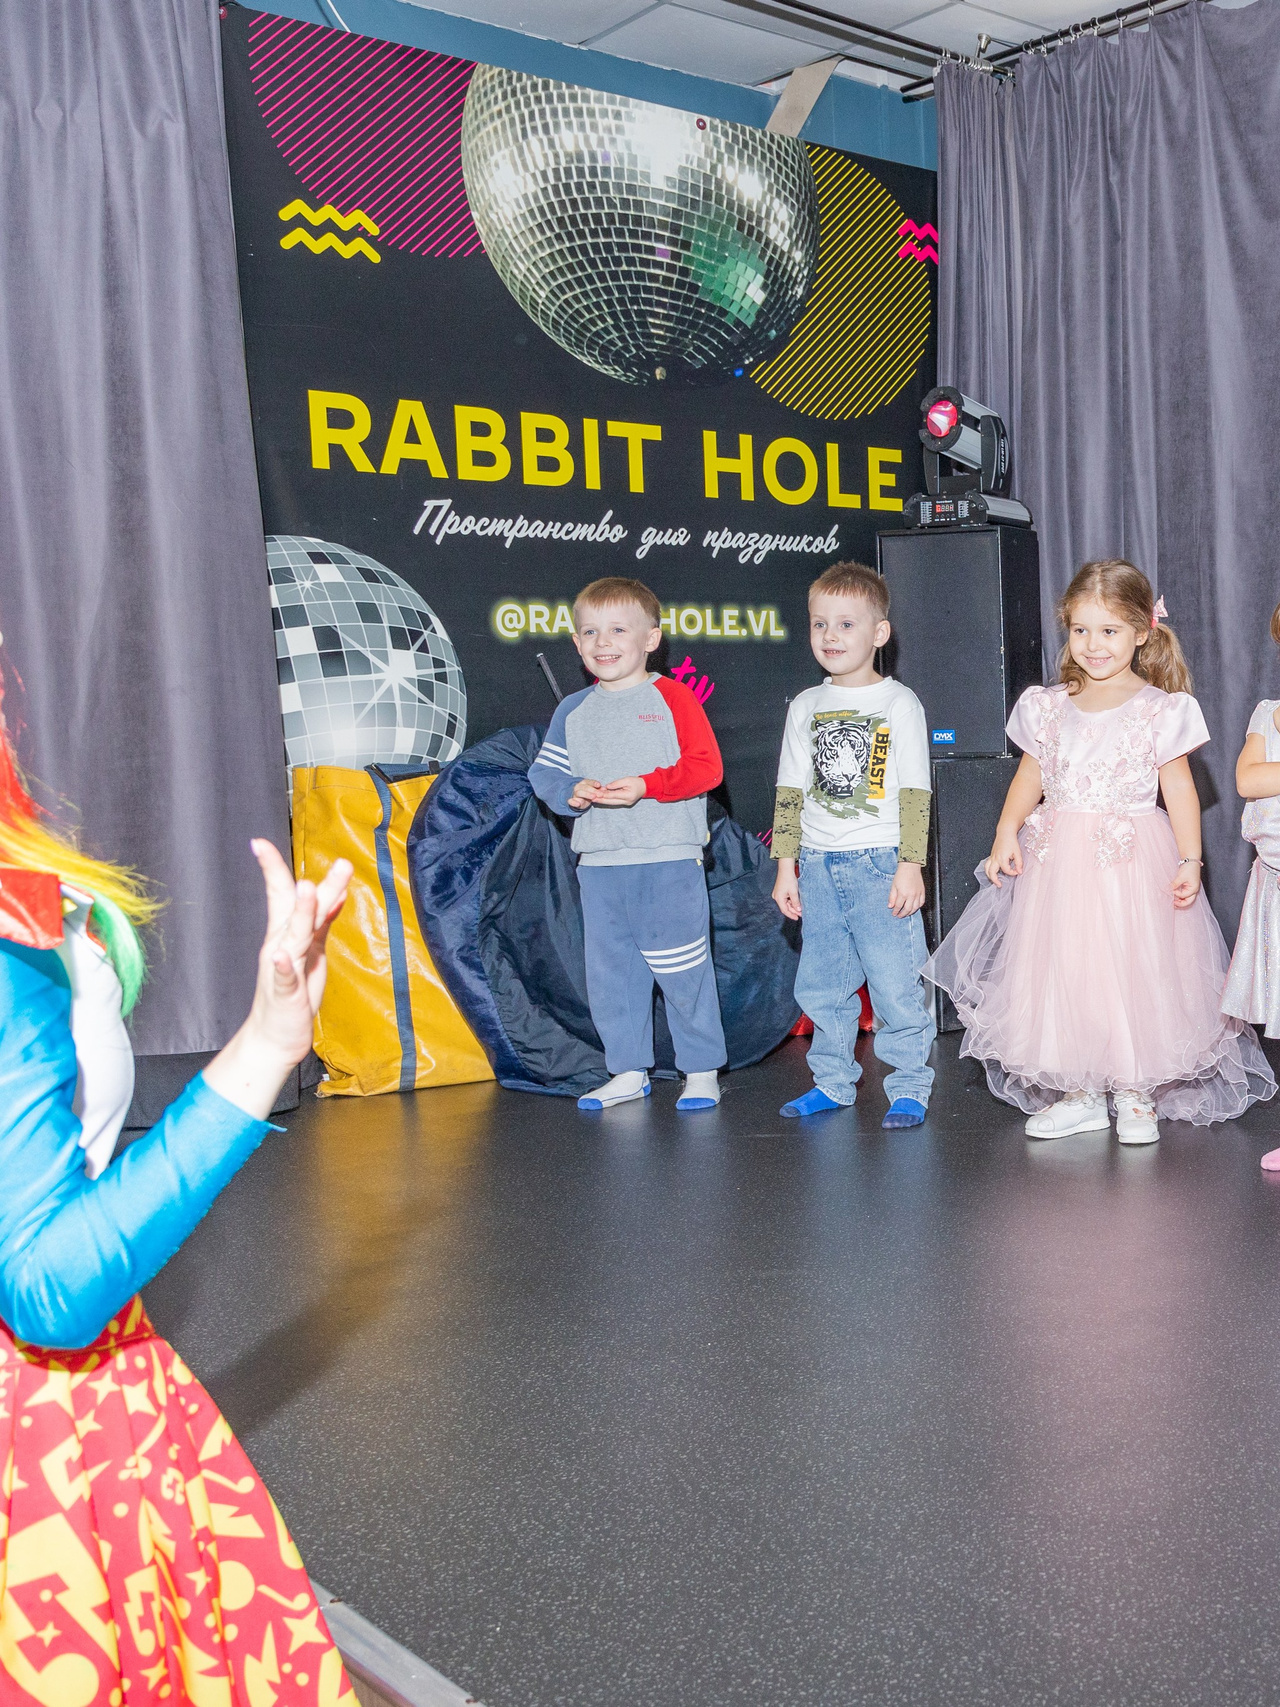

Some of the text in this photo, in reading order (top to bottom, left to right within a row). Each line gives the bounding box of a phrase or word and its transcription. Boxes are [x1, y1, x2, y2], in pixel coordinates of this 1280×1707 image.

[307, 389, 903, 511] RABBIT HOLE
[413, 498, 628, 547] Пространство
[703, 524, 840, 564] праздников
[496, 603, 784, 637] @RAHOLE.VL
[870, 732, 889, 789] BEAST
[933, 732, 953, 741] DMX
